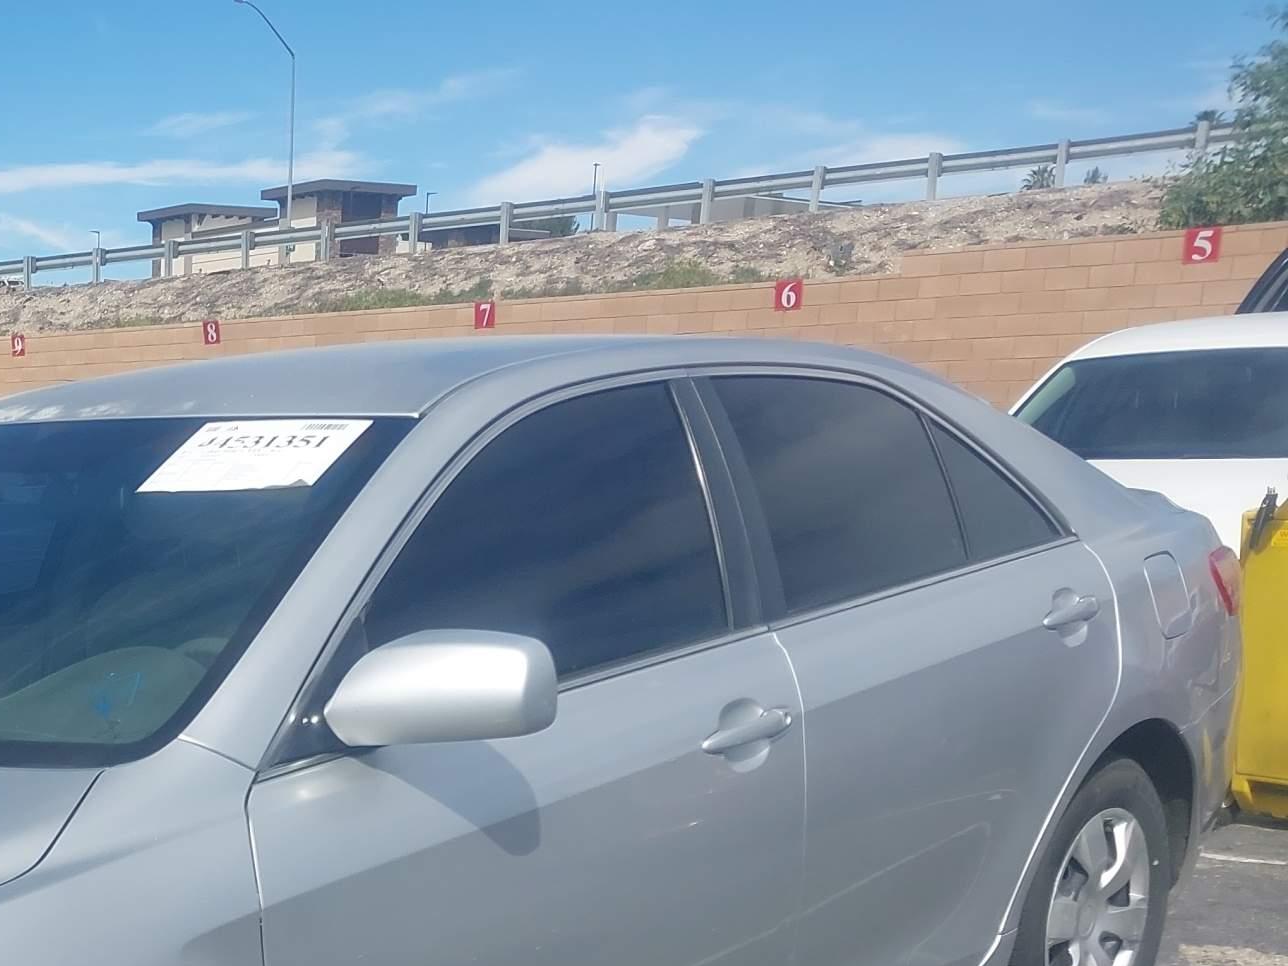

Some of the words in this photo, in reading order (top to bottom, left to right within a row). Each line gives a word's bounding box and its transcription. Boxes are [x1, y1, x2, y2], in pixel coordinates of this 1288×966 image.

[1191, 230, 1213, 260] 5
[781, 282, 795, 307] 6
[479, 304, 491, 327] 7
[207, 323, 217, 342] 8
[14, 336, 23, 355] 9
